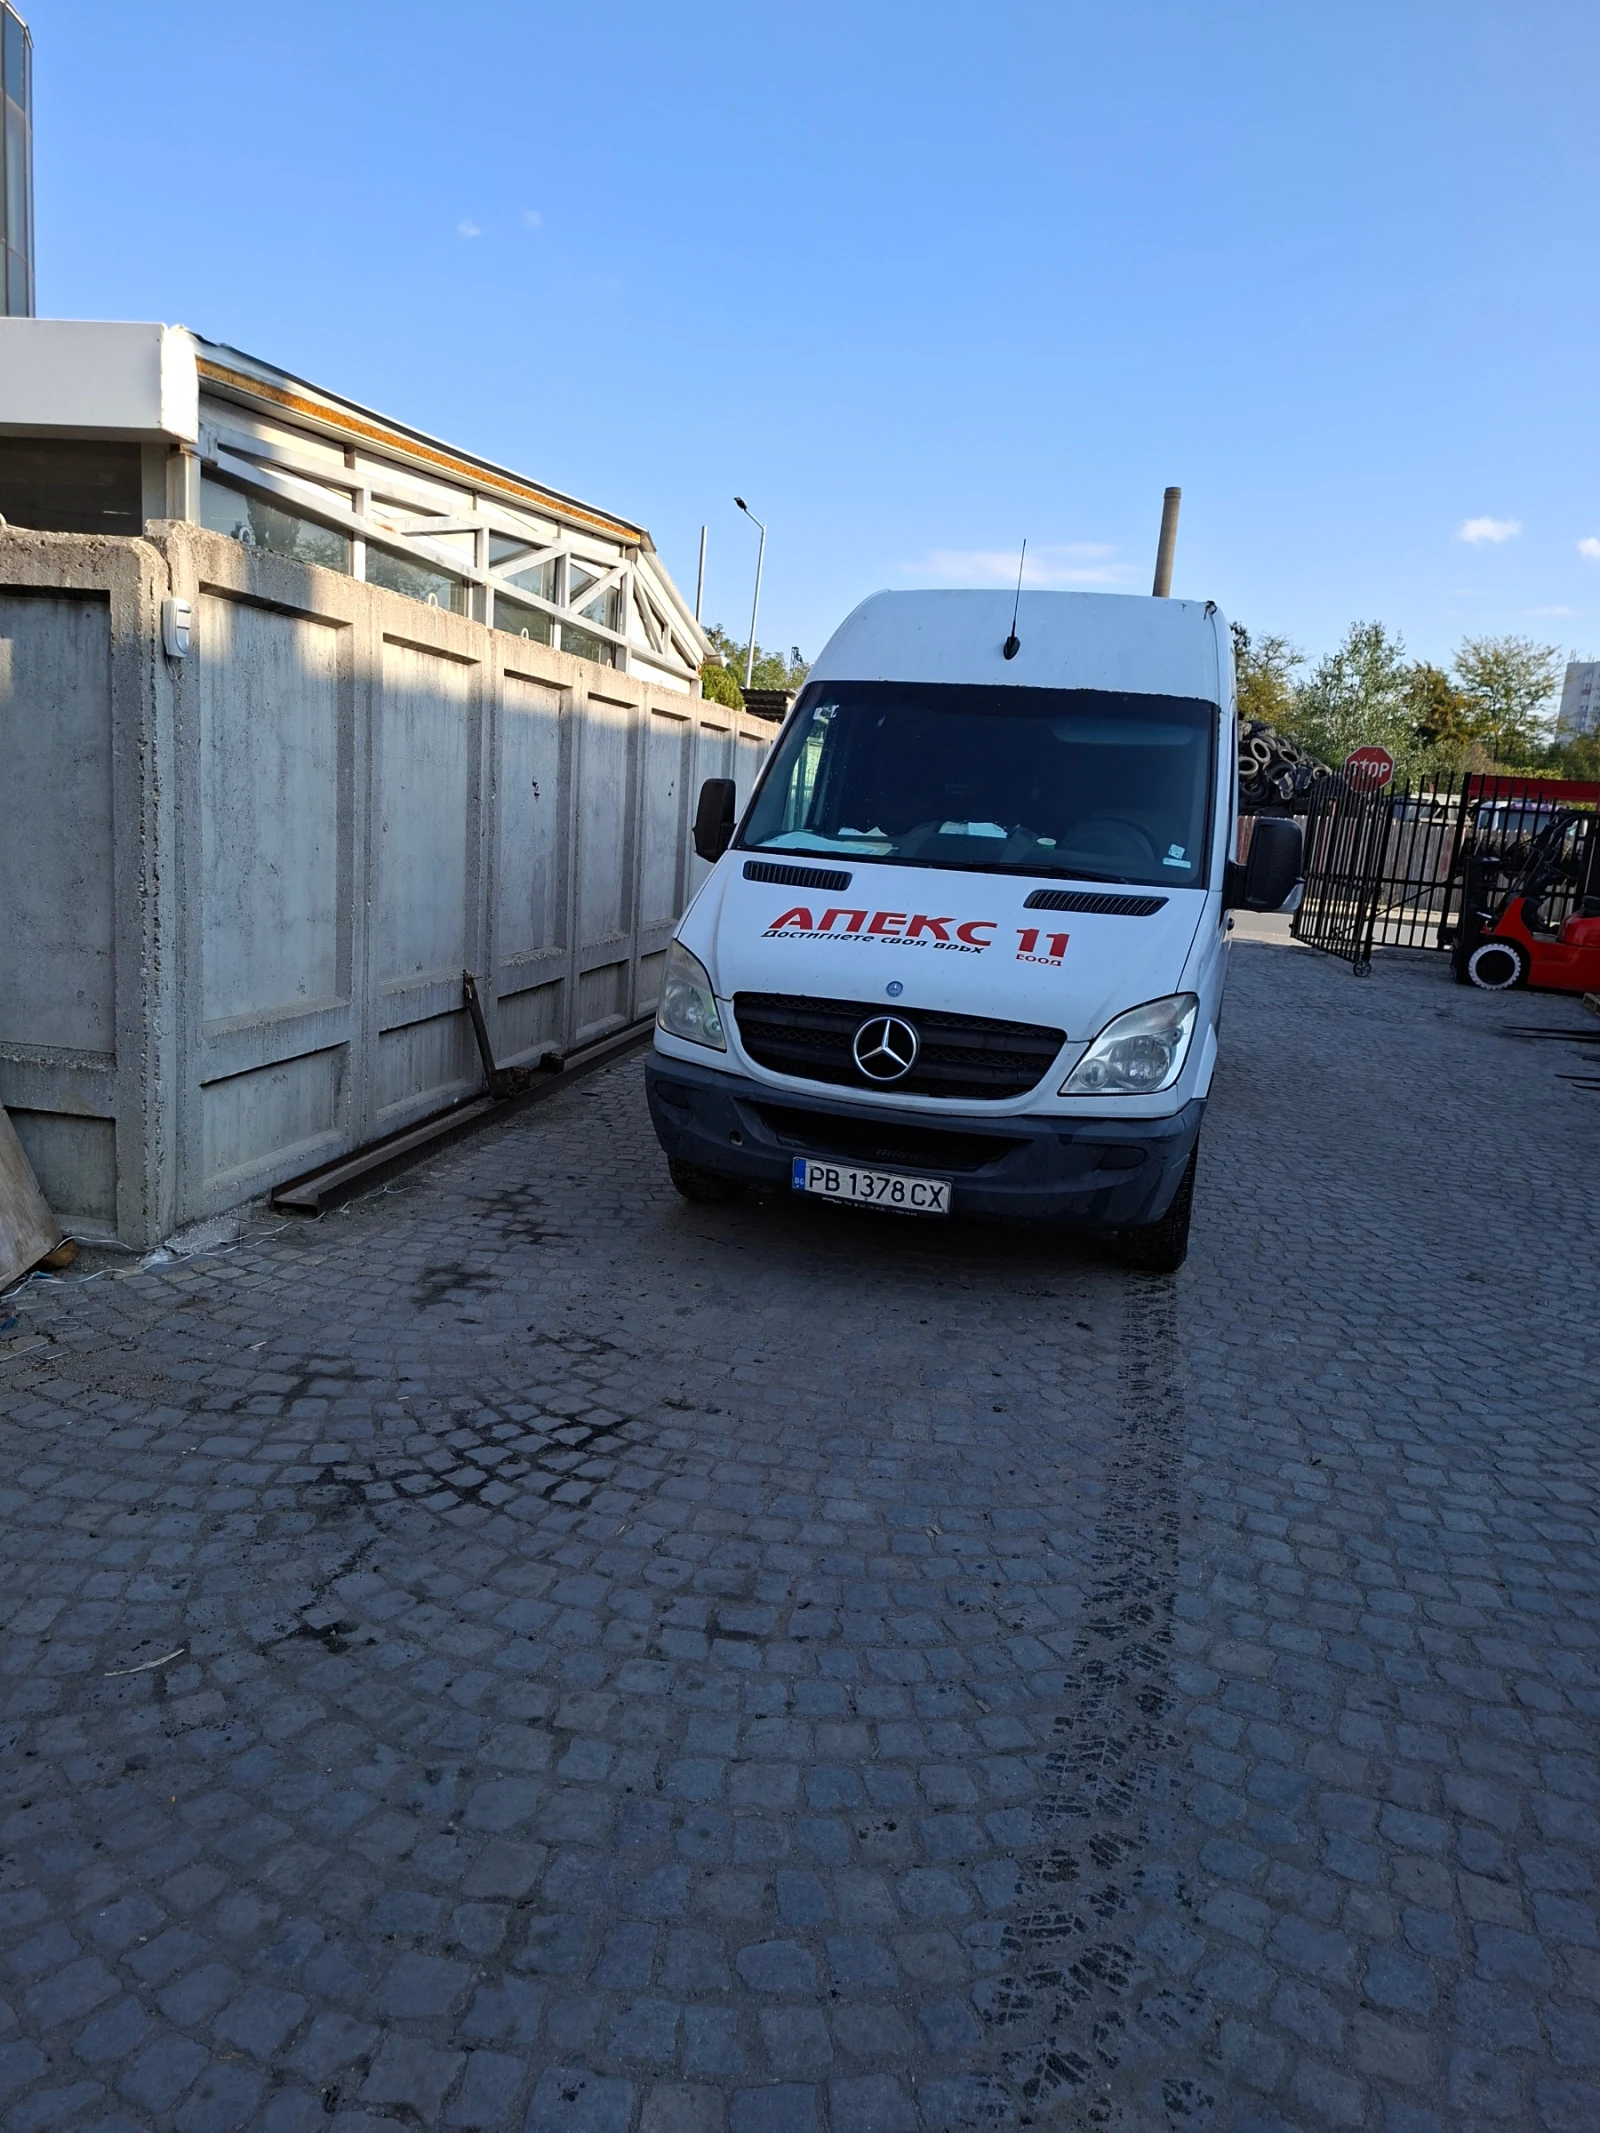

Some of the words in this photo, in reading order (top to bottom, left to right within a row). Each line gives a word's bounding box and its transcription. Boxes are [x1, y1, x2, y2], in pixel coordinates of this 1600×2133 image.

[761, 930, 875, 942] Достигнете
[768, 907, 998, 946] АПЕКС
[1016, 928, 1070, 958] 11
[808, 1166, 841, 1192] PB
[849, 1172, 905, 1203] 1378
[910, 1183, 944, 1209] CX
